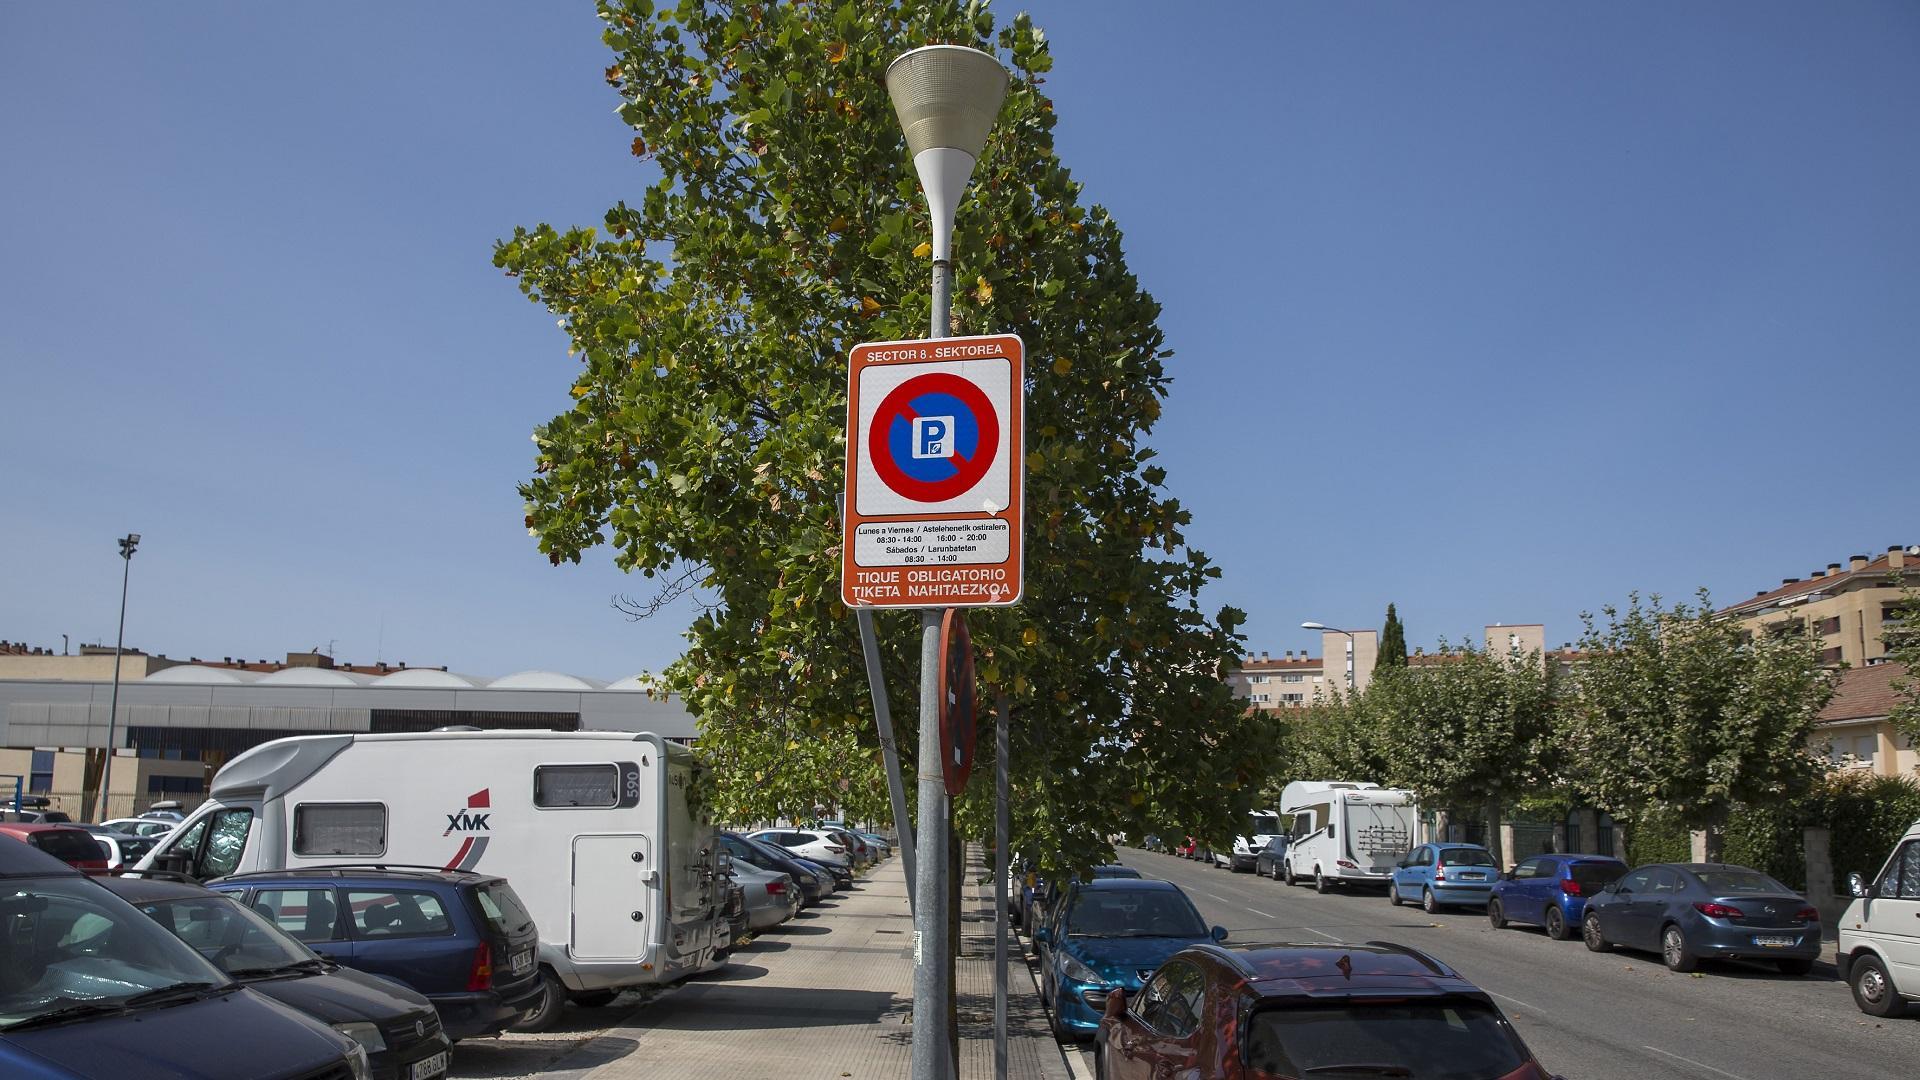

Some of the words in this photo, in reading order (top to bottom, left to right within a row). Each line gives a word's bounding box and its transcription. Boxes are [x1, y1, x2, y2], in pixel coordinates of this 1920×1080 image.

[867, 349, 917, 363] SECTOR
[935, 344, 1003, 358] SEKTOREA
[921, 421, 946, 454] P
[858, 527, 880, 535] Lunes
[887, 526, 914, 534] Viernes
[922, 524, 971, 533] Astelehenetik
[972, 523, 1007, 531] ostiralera
[876, 536, 896, 544] 08:30
[903, 535, 922, 543] 14:00
[937, 534, 957, 542] 16:00
[966, 533, 987, 541] 20:00
[886, 546, 918, 554] Sábados
[928, 544, 977, 553] Larunbatetan
[904, 555, 925, 563] 08:30
[937, 554, 957, 562] 14:00
[857, 571, 900, 584] TIQUE
[907, 568, 1006, 583] OBLIGATORIO
[852, 585, 900, 598] TIKETA
[908, 583, 1010, 597] NAHITAEZKOA
[626, 771, 639, 798] 590
[443, 809, 491, 835] XMK
